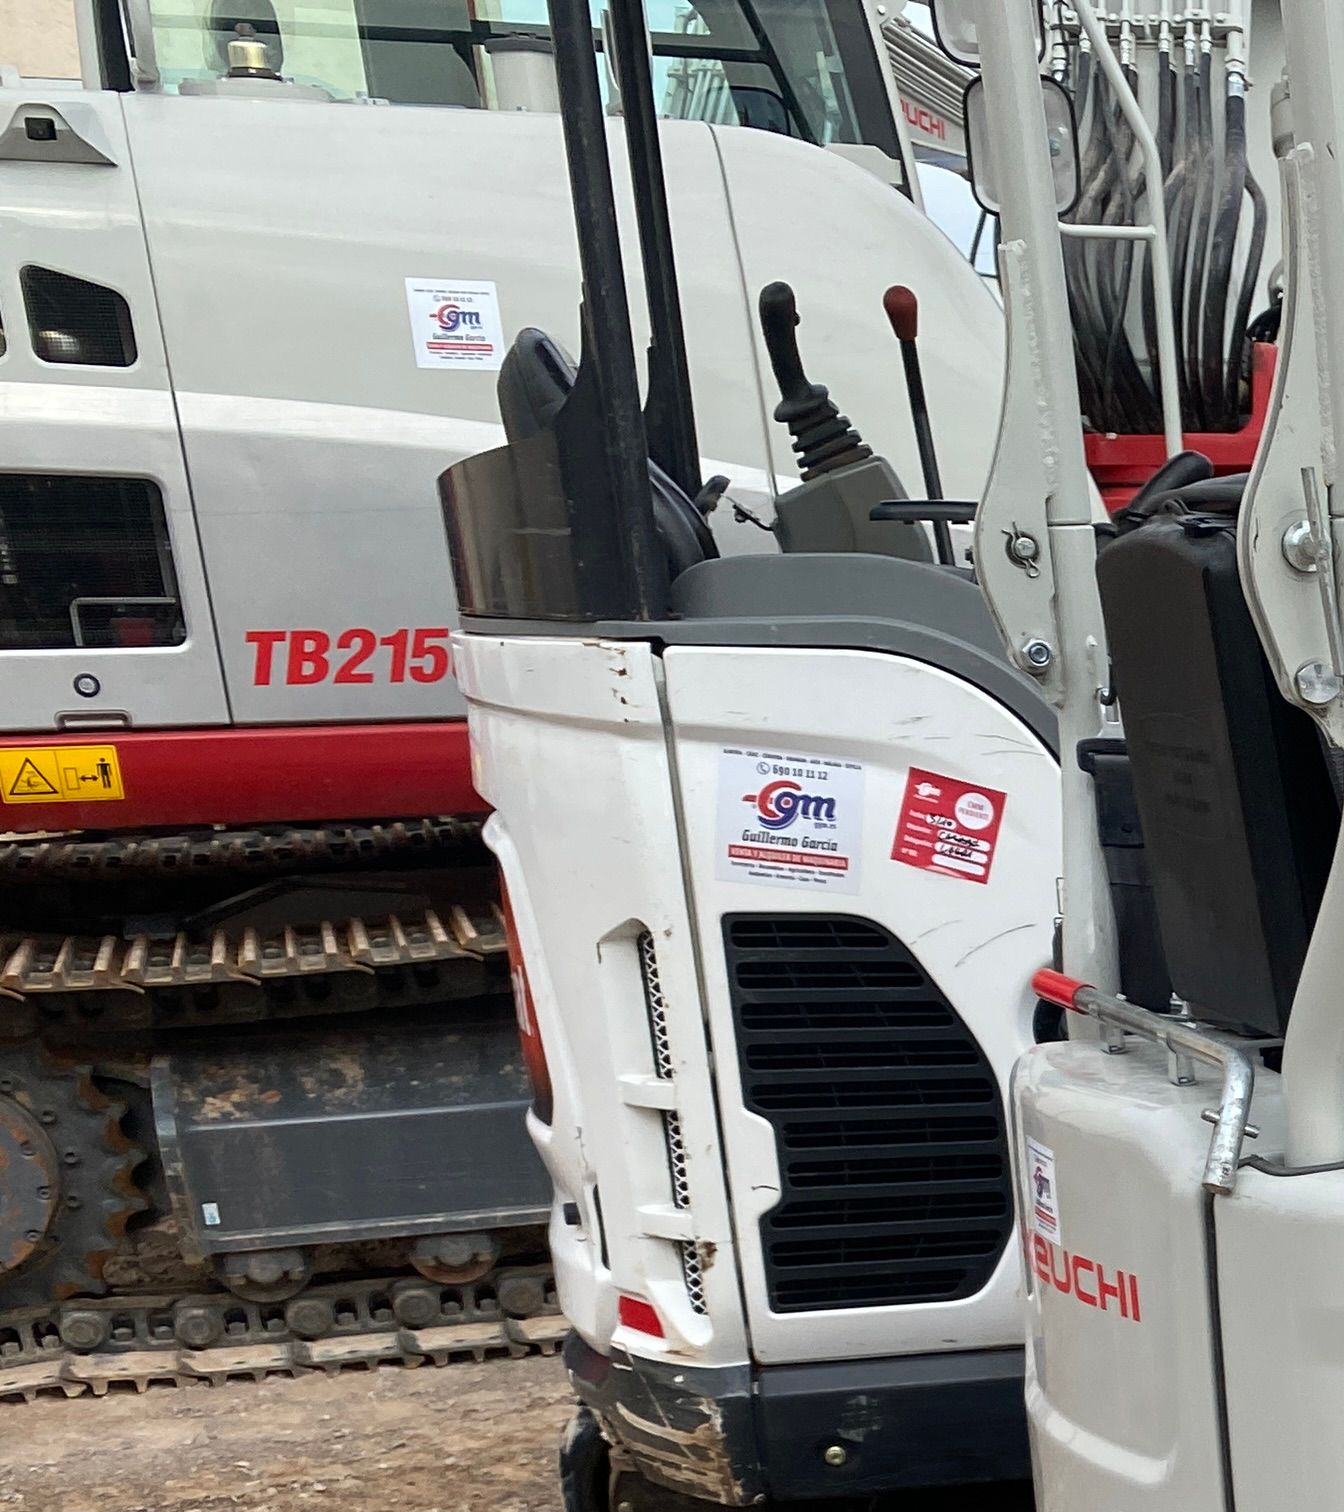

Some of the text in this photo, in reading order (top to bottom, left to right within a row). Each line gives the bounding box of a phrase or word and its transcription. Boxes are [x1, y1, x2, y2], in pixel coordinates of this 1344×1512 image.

[901, 98, 945, 140] UCHI
[245, 628, 457, 686] TB215
[772, 764, 829, 781] 690 10 11 12
[741, 829, 799, 848] Guillermo
